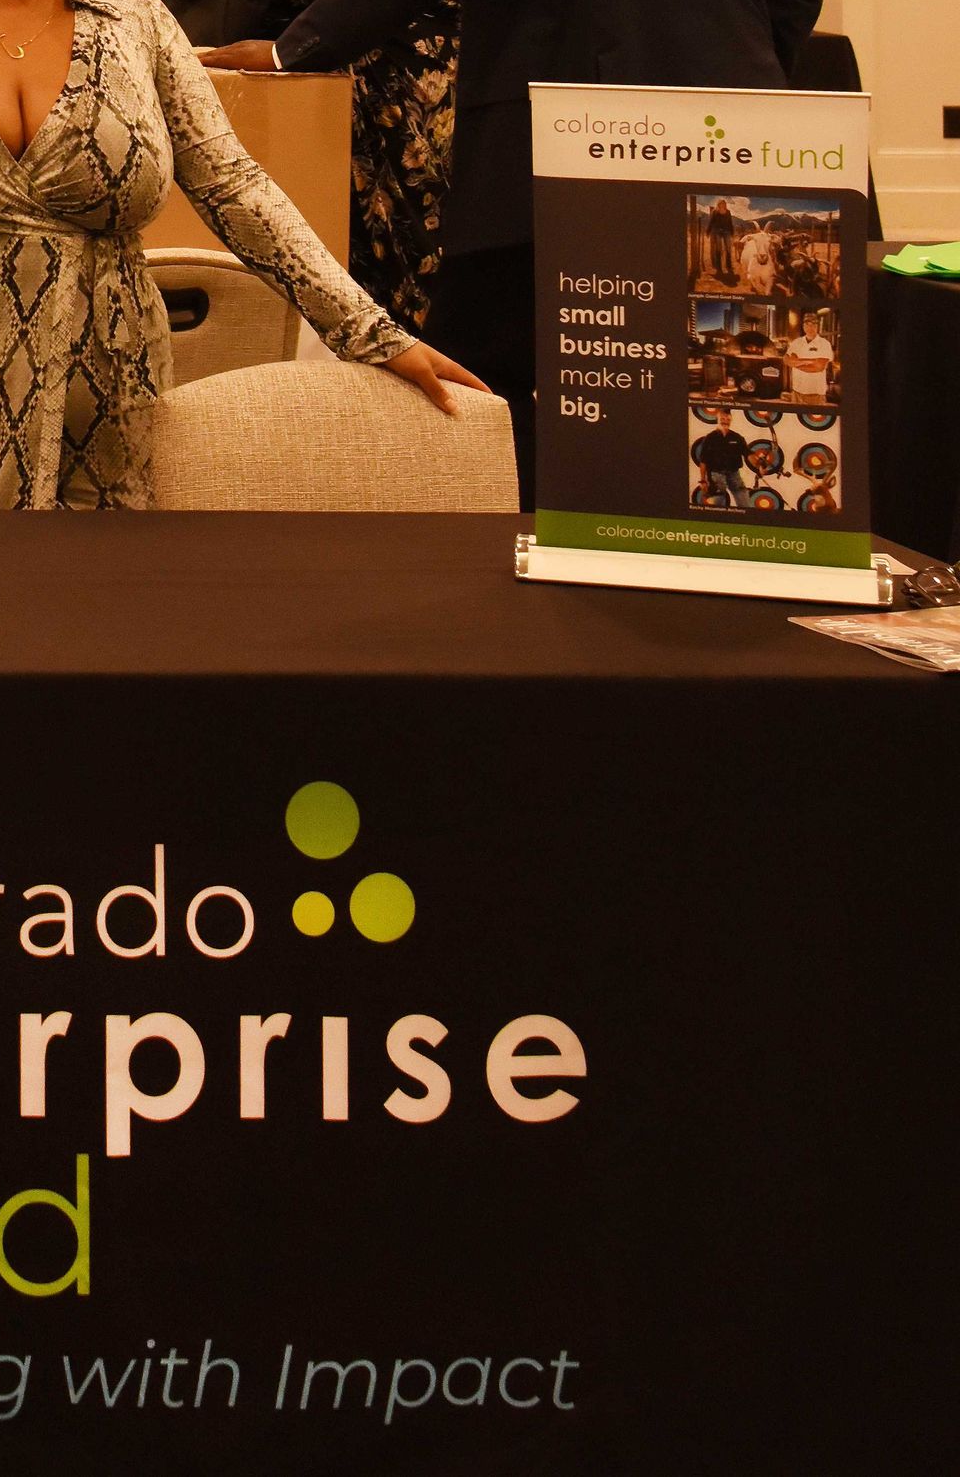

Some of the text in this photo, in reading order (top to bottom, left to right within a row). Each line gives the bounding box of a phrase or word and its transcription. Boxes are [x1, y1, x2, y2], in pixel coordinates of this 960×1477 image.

[553, 112, 666, 137] colorado
[588, 139, 844, 171] enterprise fund
[559, 272, 655, 302] helping
[559, 306, 626, 327] small
[559, 333, 667, 360] business
[560, 367, 655, 390] make it
[560, 395, 607, 423] big.
[596, 525, 807, 554] coloradoenterprisefund.org
[63, 1338, 241, 1409] with
[276, 1345, 581, 1427] Impact
